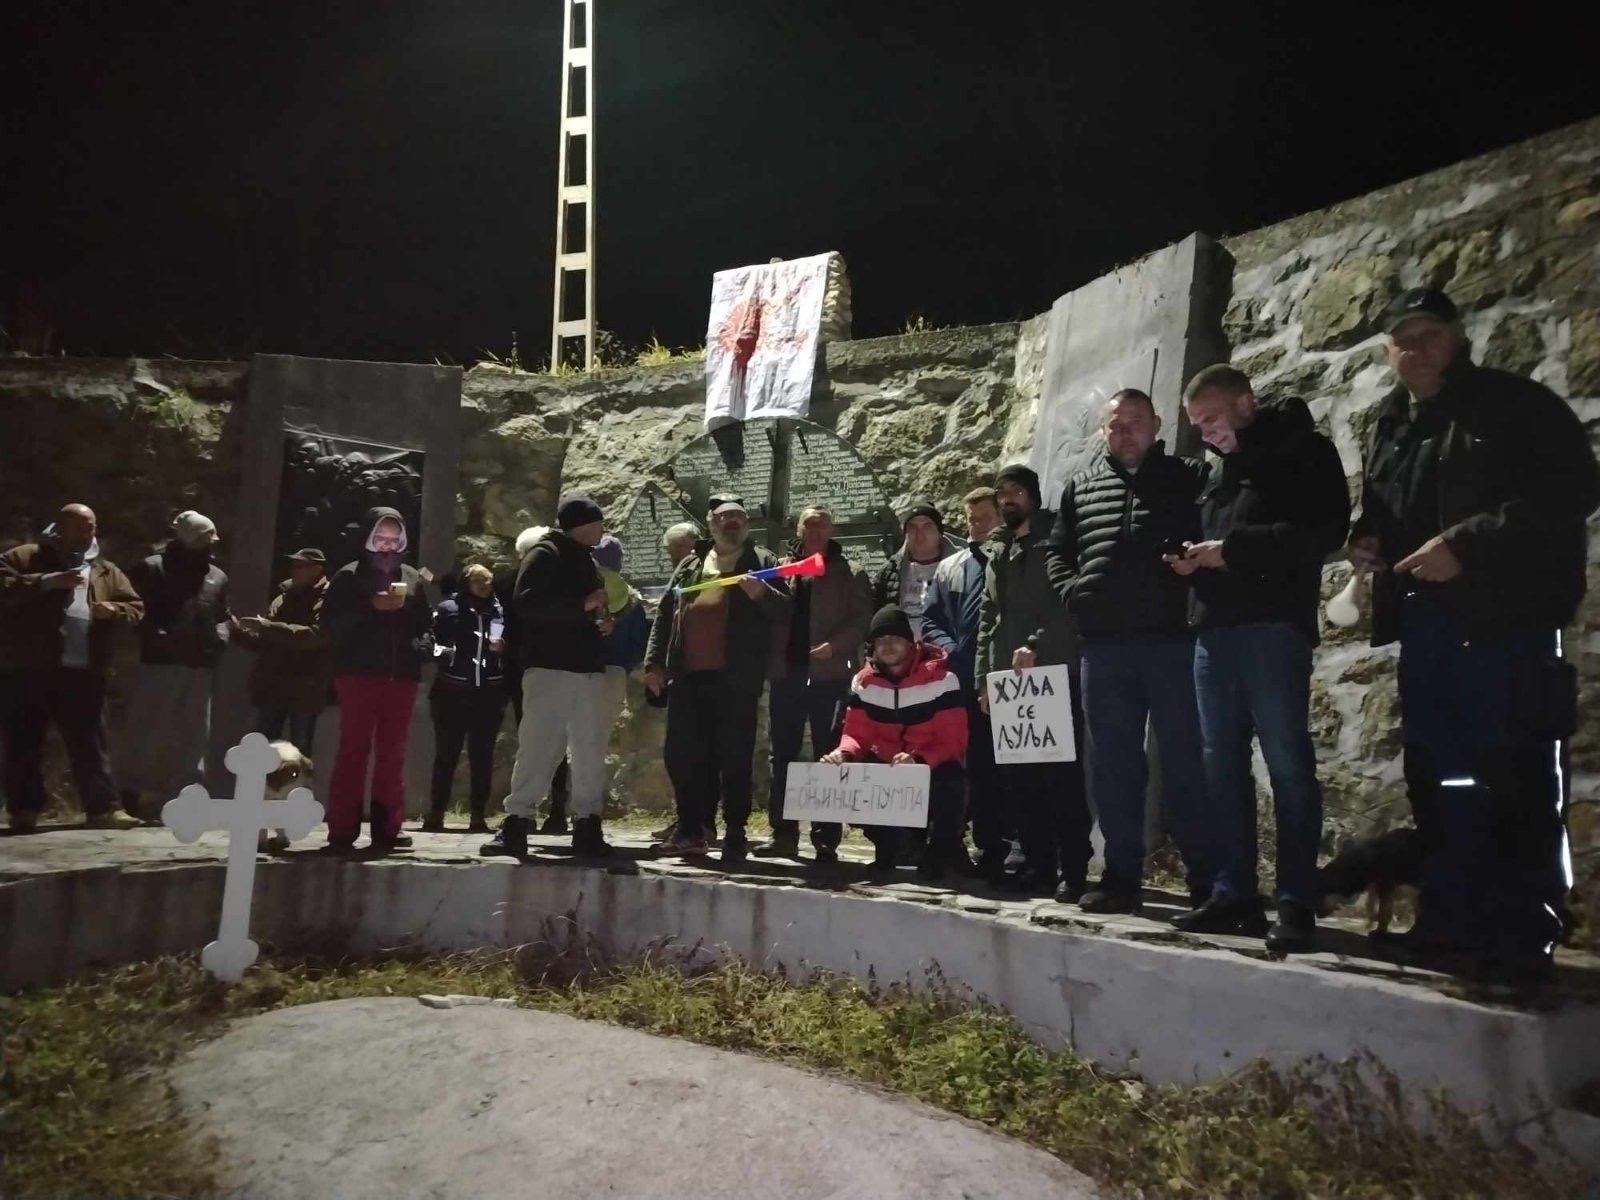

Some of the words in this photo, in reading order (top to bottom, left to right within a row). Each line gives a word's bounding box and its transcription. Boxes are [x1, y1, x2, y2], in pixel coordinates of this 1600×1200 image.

[993, 674, 1054, 704] ХУЉА
[1017, 705, 1035, 719] СЕ
[998, 722, 1056, 750] ЉУЉА
